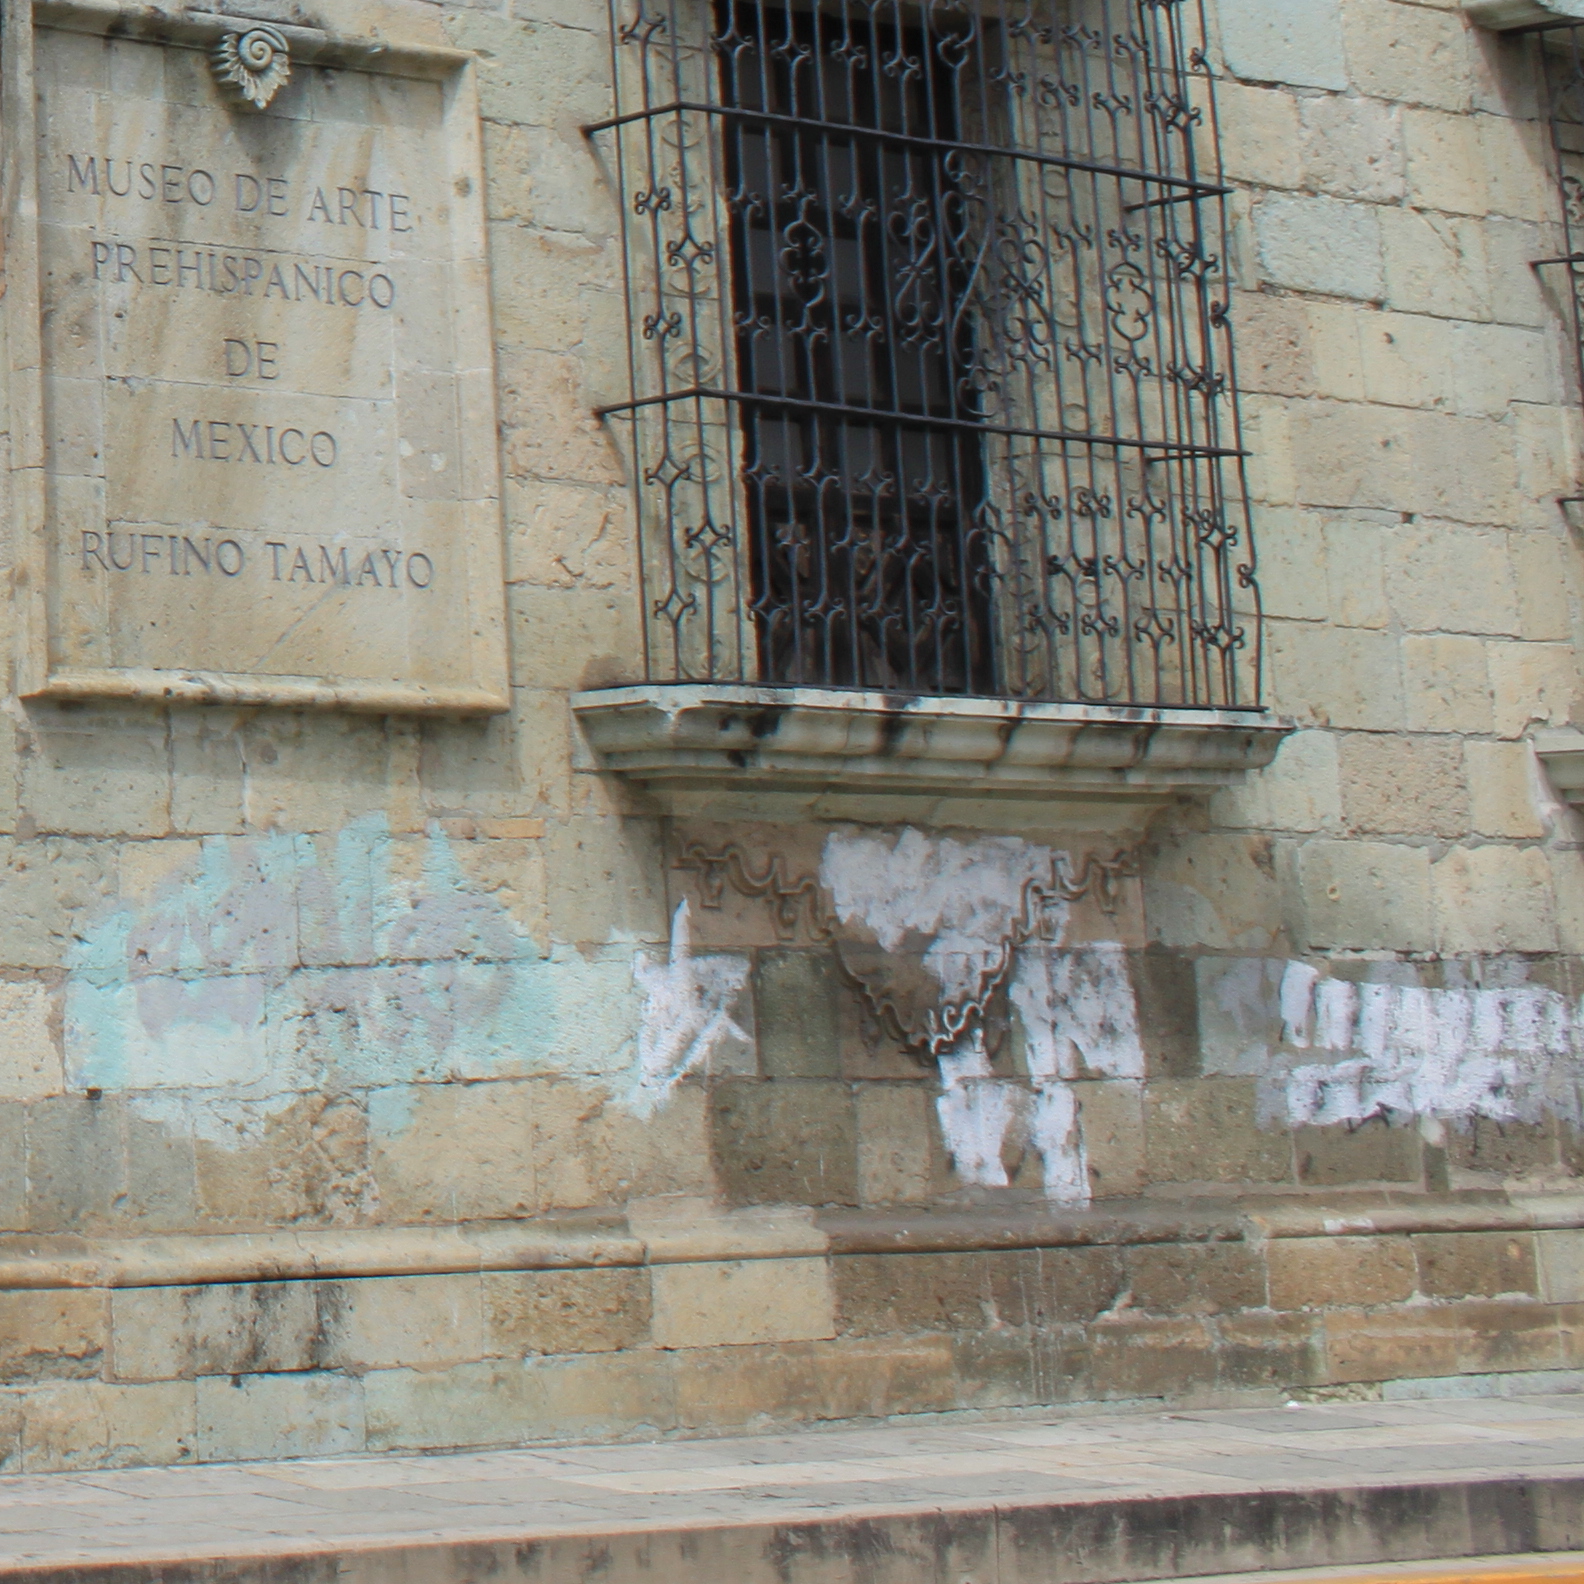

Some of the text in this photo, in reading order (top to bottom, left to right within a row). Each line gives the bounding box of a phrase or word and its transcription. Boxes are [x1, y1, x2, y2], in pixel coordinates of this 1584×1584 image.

[67, 153, 414, 233] MUSEO DE ARTE
[90, 240, 396, 310] PREHISPANICO
[223, 337, 280, 380] DE
[171, 417, 338, 468] MEXICO
[81, 529, 434, 590] RUFINO TAMAYO
